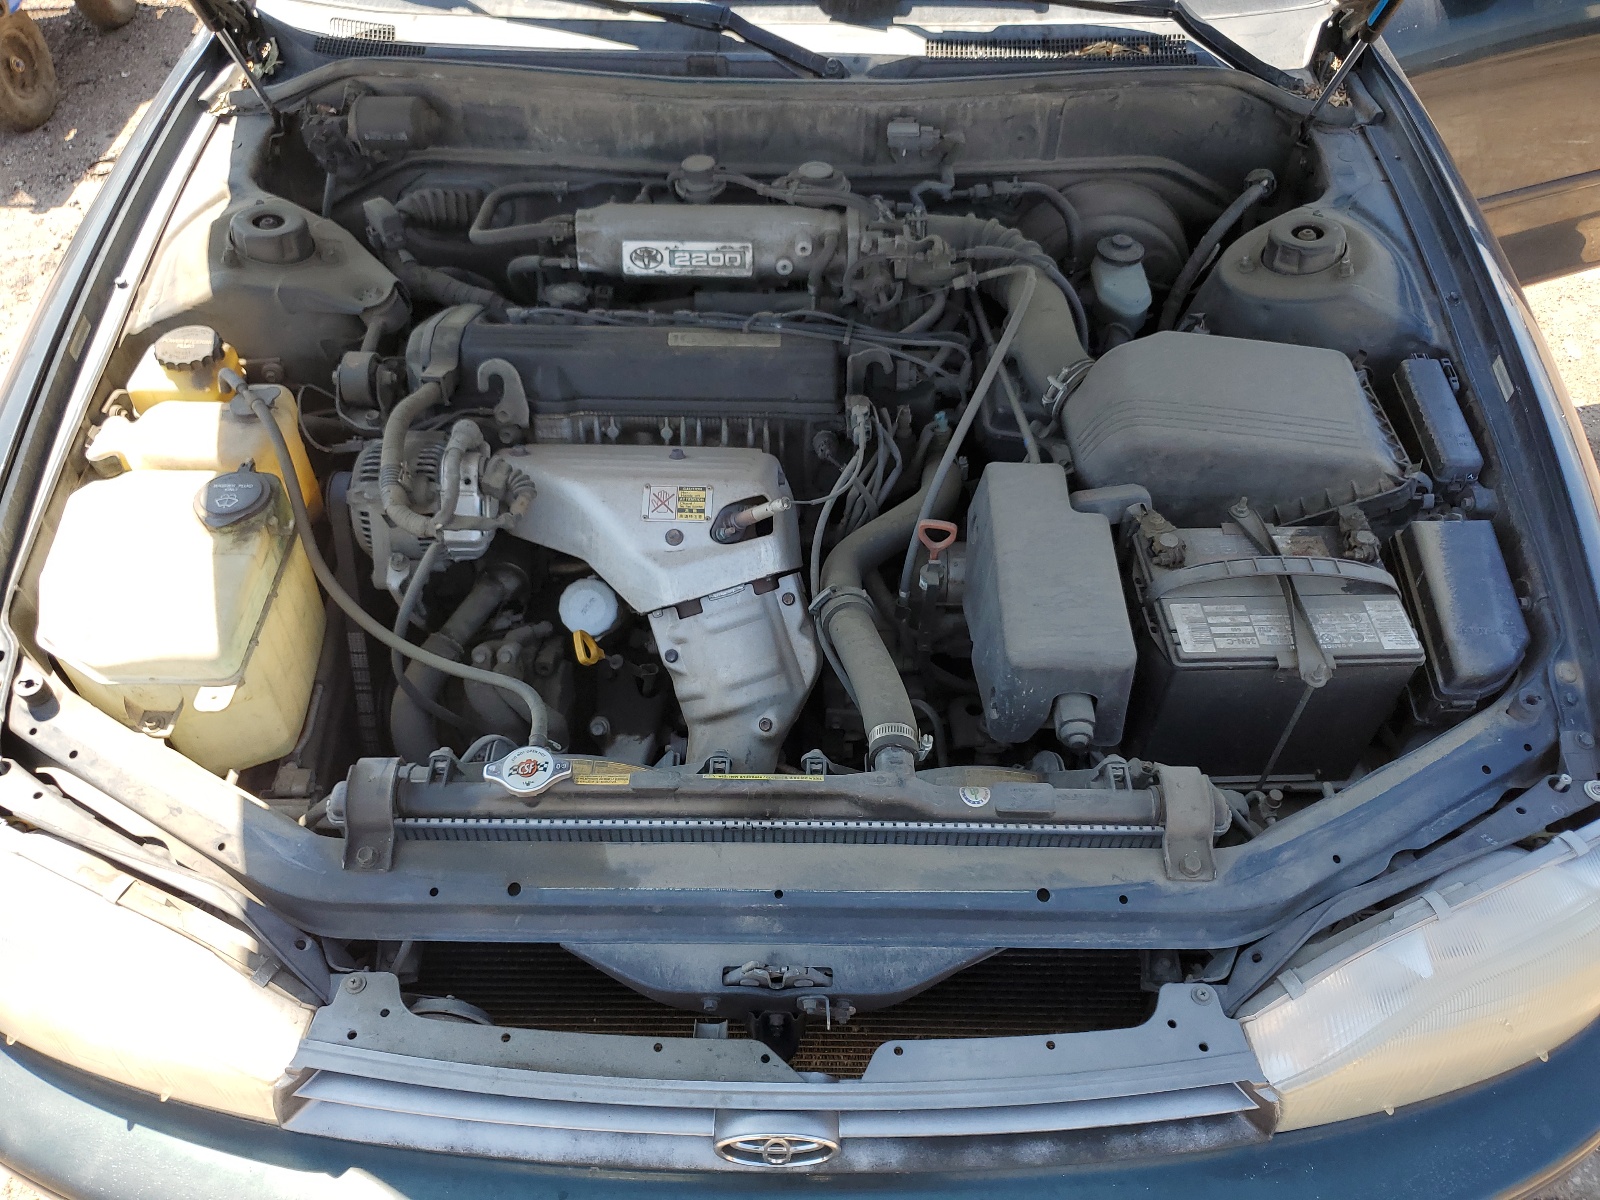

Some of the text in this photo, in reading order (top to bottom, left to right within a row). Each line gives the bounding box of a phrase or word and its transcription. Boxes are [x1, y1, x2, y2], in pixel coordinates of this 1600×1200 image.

[675, 252, 741, 266] 2200
[1226, 638, 1257, 646] 35N-C
[518, 762, 535, 775] CSF
